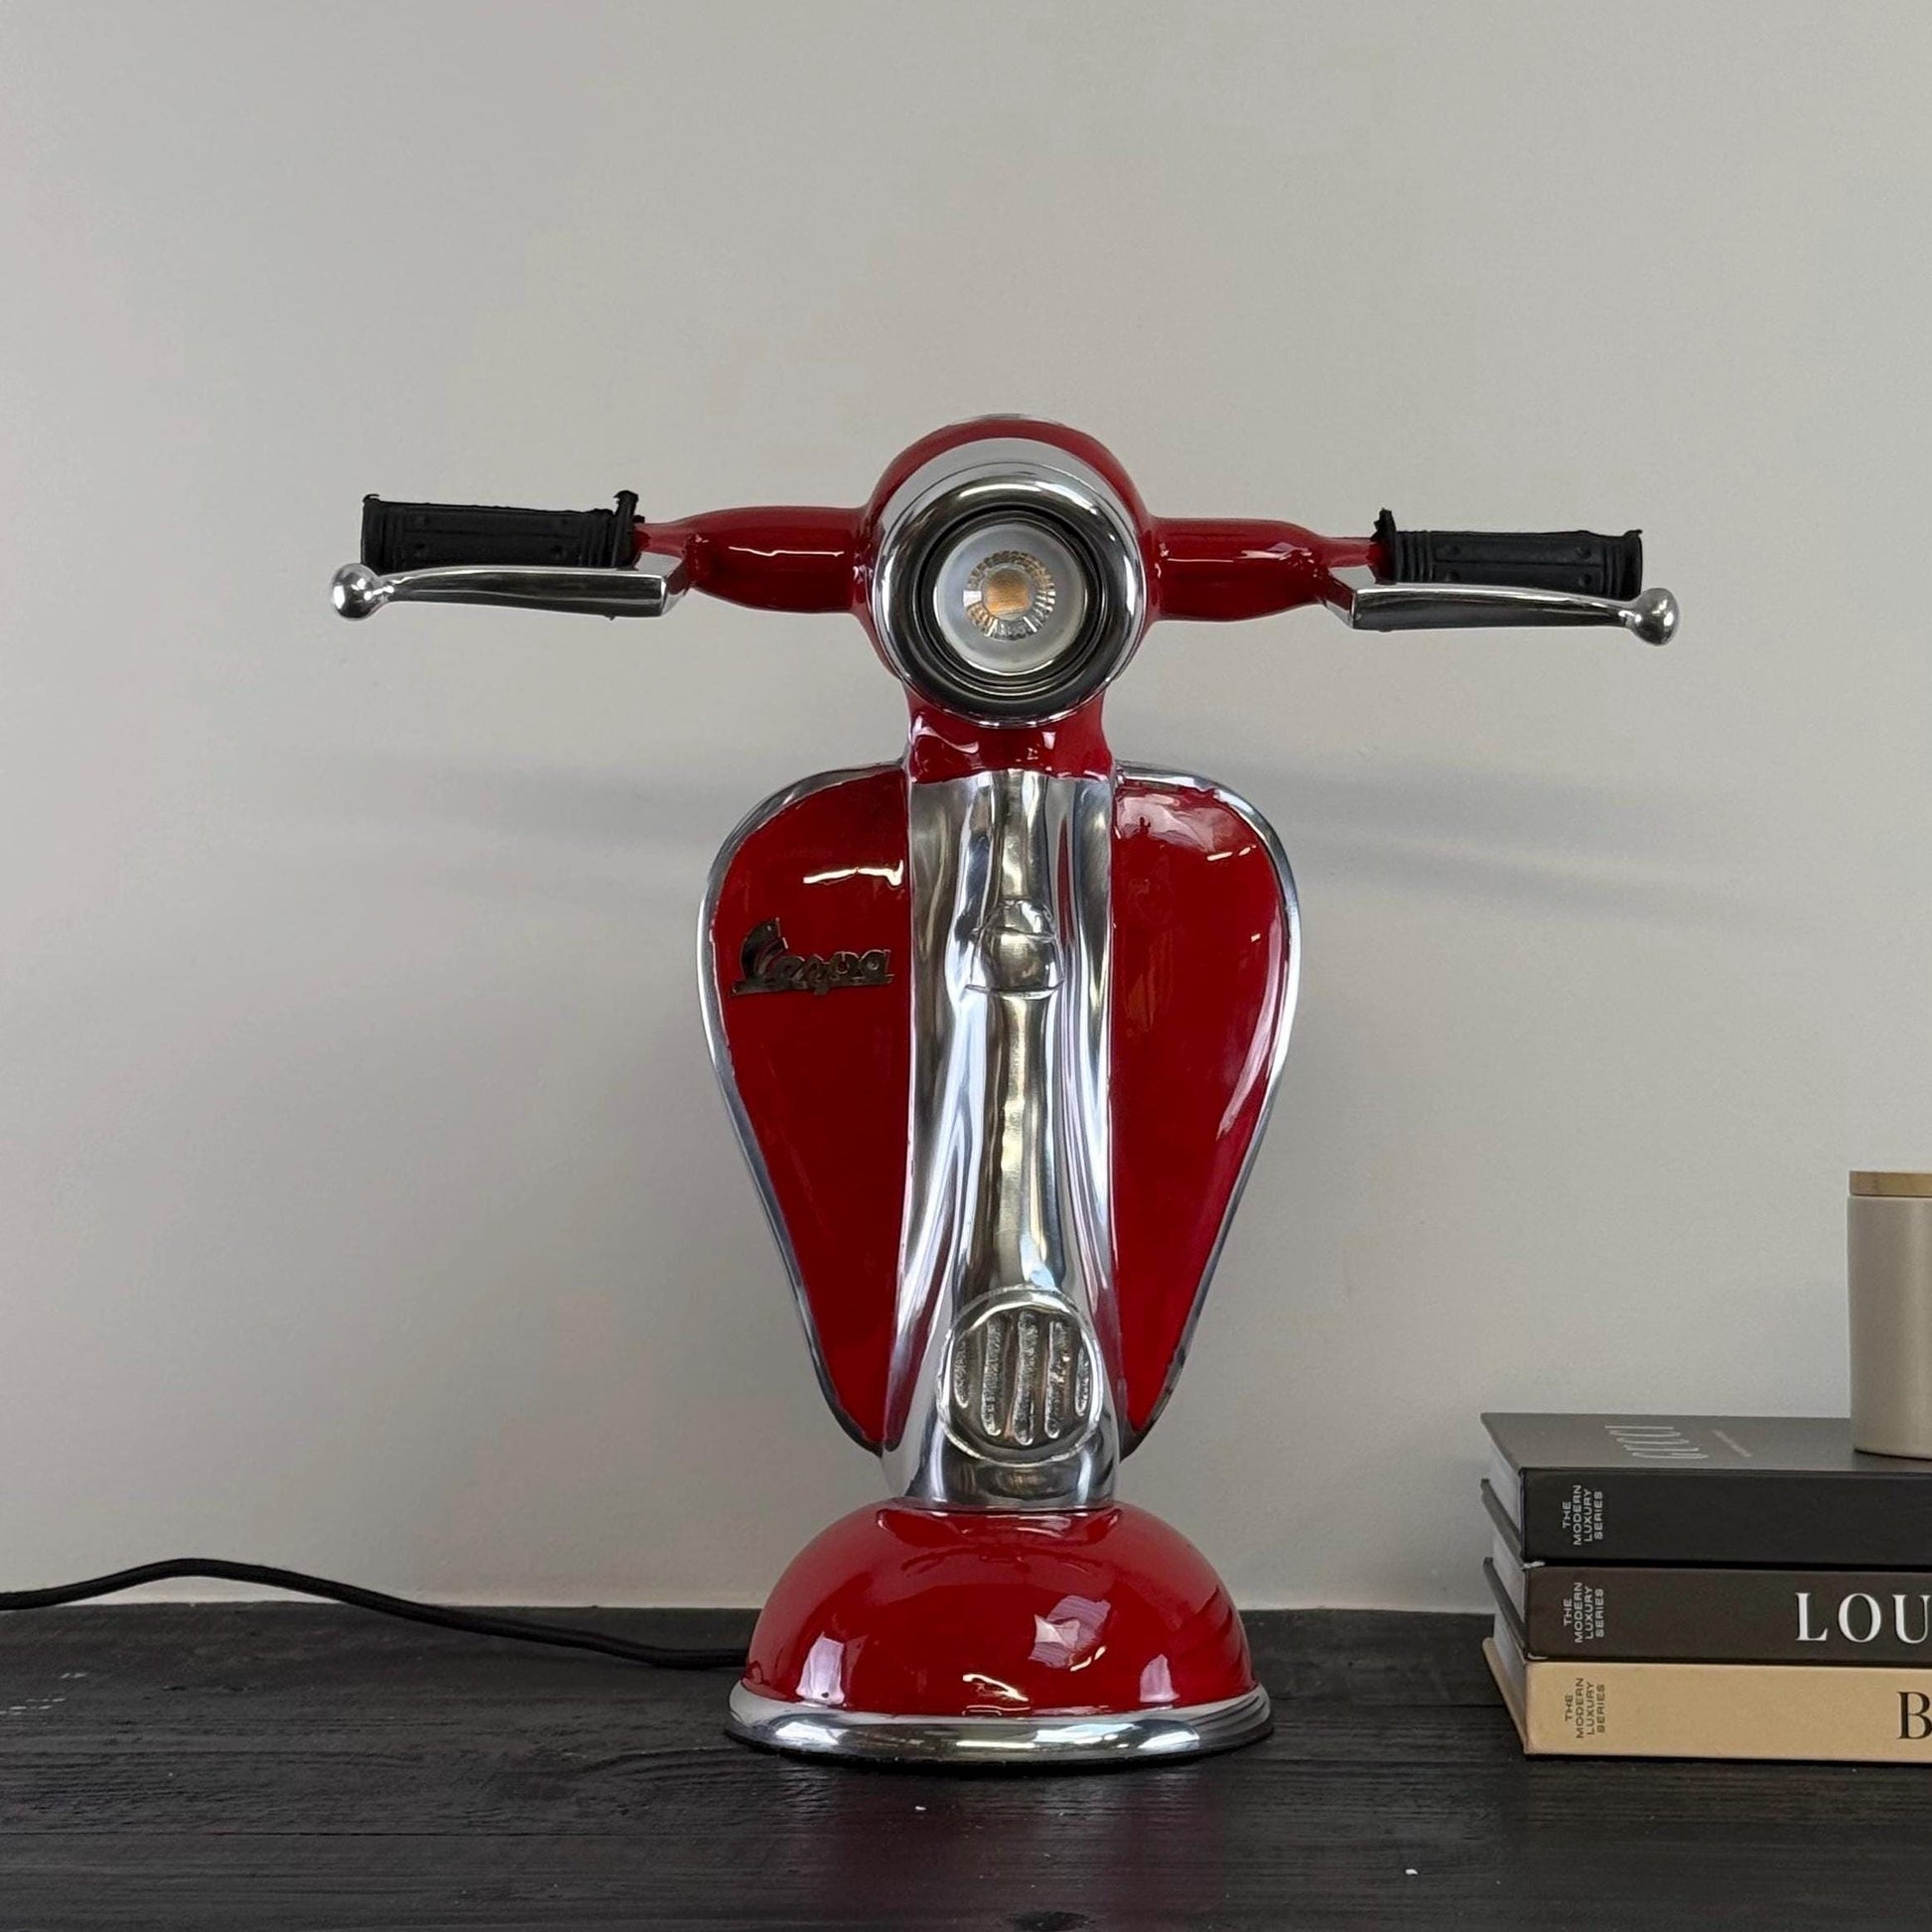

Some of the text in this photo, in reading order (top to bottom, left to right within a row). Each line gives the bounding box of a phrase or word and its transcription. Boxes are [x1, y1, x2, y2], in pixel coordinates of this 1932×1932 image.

[1562, 1501, 1572, 1529] THE
[1572, 1484, 1583, 1546] MODERN
[1583, 1488, 1593, 1542] LUXURY
[1593, 1491, 1603, 1540] SERIES
[1563, 1598, 1573, 1626] THE
[1573, 1582, 1584, 1643] MODERN
[1584, 1586, 1593, 1640] LUXURY
[1594, 1588, 1604, 1638] SERIES
[1795, 1591, 1931, 1644] LOU
[1564, 1695, 1574, 1723] THE
[1575, 1677, 1585, 1739] MODERN
[1586, 1681, 1595, 1735] LUXURY
[1595, 1683, 1605, 1733] SERIES
[1896, 1691, 1932, 1740] B
